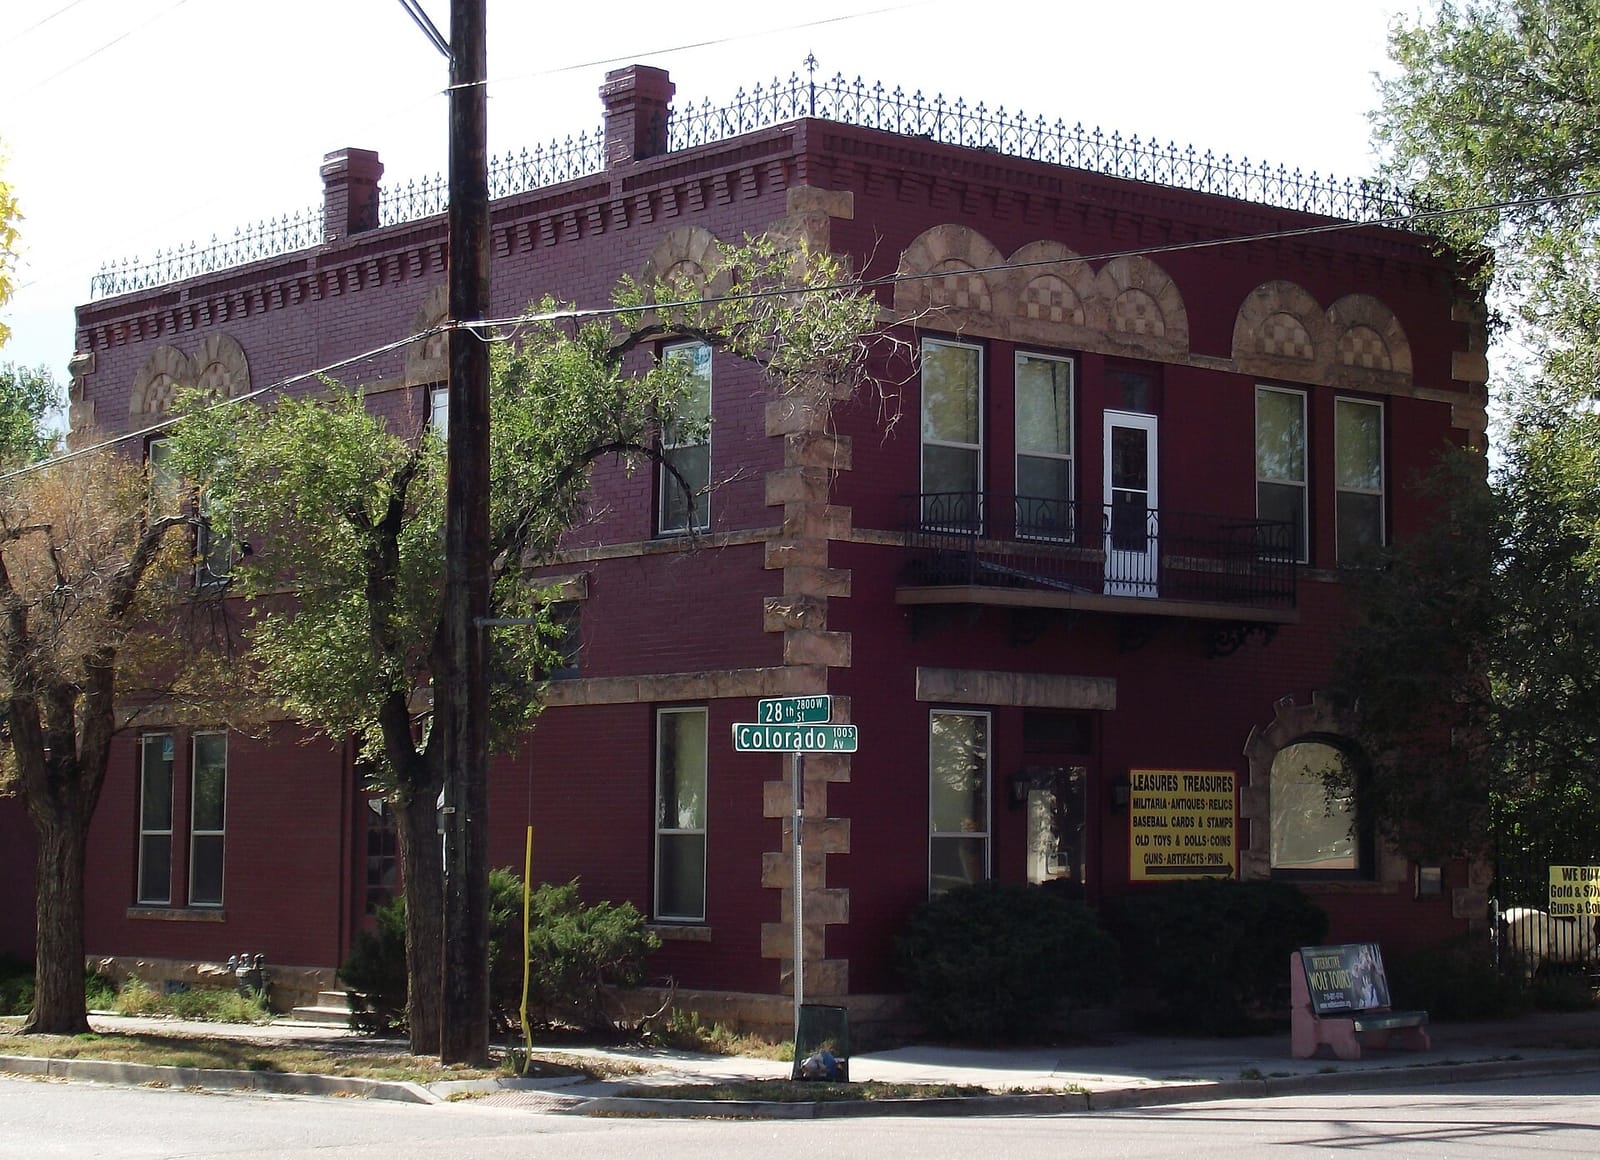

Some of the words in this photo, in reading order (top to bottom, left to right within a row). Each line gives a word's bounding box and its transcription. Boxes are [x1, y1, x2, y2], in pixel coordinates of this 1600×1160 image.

[797, 698, 823, 710] 2800W
[797, 712, 805, 722] St
[741, 726, 826, 749] Colorado
[833, 727, 853, 738] 100S
[833, 740, 844, 750] Av
[1133, 775, 1178, 792] LEASURES
[1183, 775, 1233, 793] TREASURES
[1133, 816, 1168, 828] BASEBALL
[1171, 816, 1195, 828] CARDS
[1206, 817, 1233, 829] STAMPS
[1135, 835, 1150, 846] OLD
[1153, 835, 1172, 847] TOYS
[1561, 867, 1578, 881] WE
[1580, 868, 1599, 881] BUY
[1550, 884, 1573, 898] Gold
[1574, 886, 1581, 898] &
[1550, 901, 1575, 914] Guns
[1576, 903, 1583, 914] &
[1308, 971, 1329, 992] WOLF
[1328, 969, 1352, 991] TOURS
